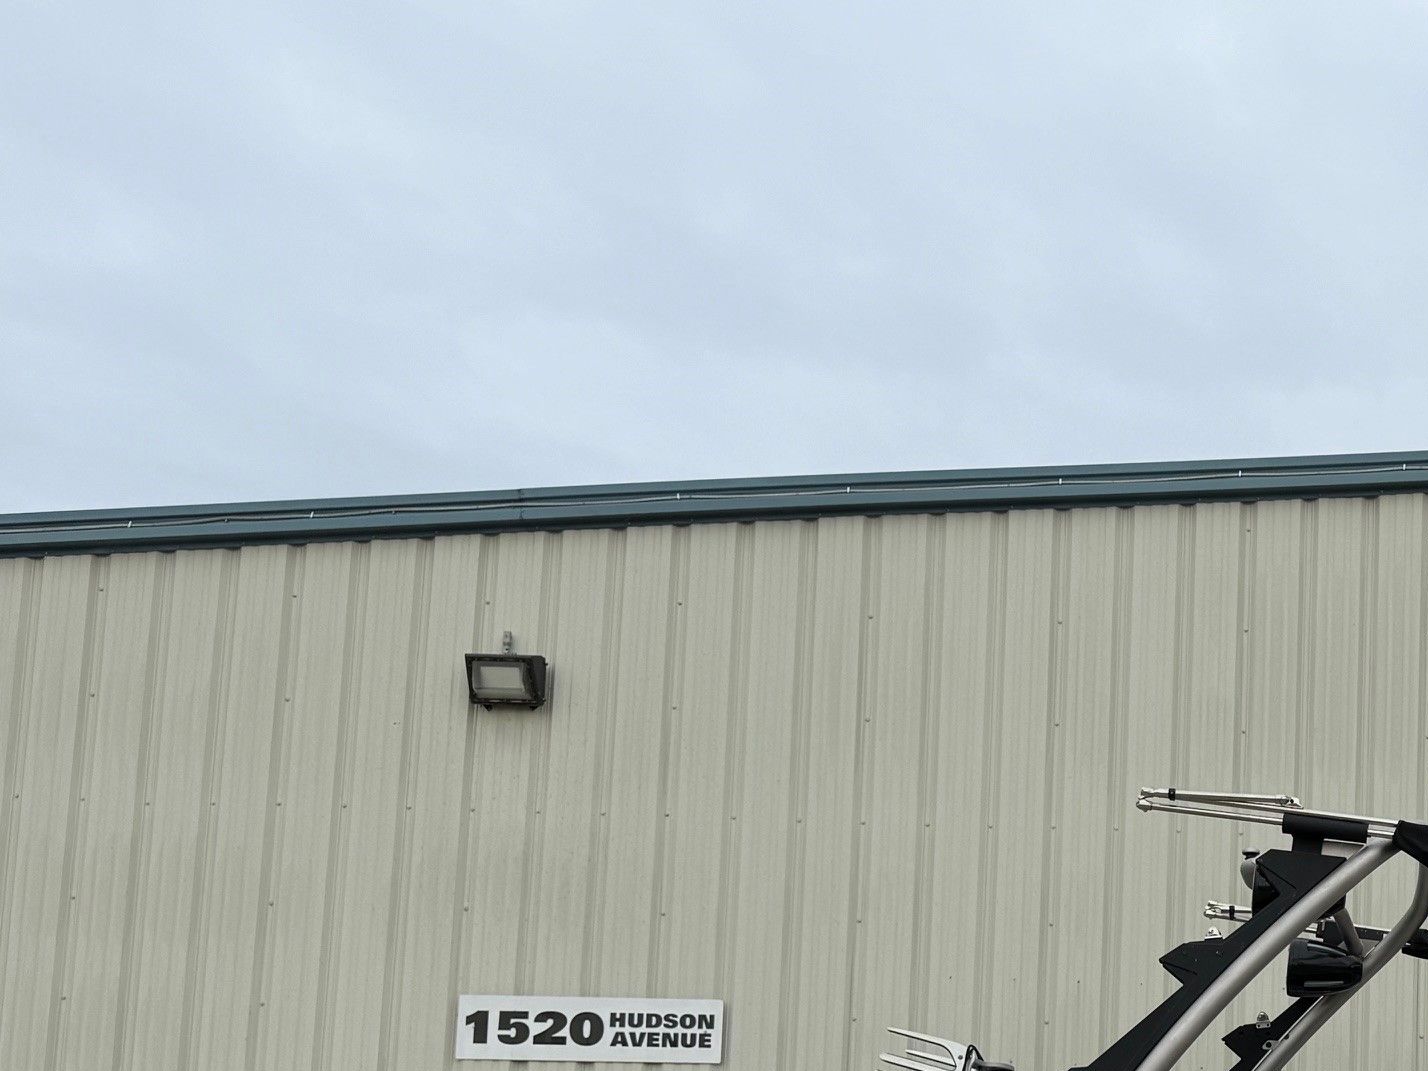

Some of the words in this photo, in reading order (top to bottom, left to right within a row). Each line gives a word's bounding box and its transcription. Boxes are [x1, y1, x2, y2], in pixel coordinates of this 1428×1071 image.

[465, 1010, 604, 1046] 1520
[609, 1012, 715, 1030] HUDSON
[610, 1032, 712, 1049] AVENUE
